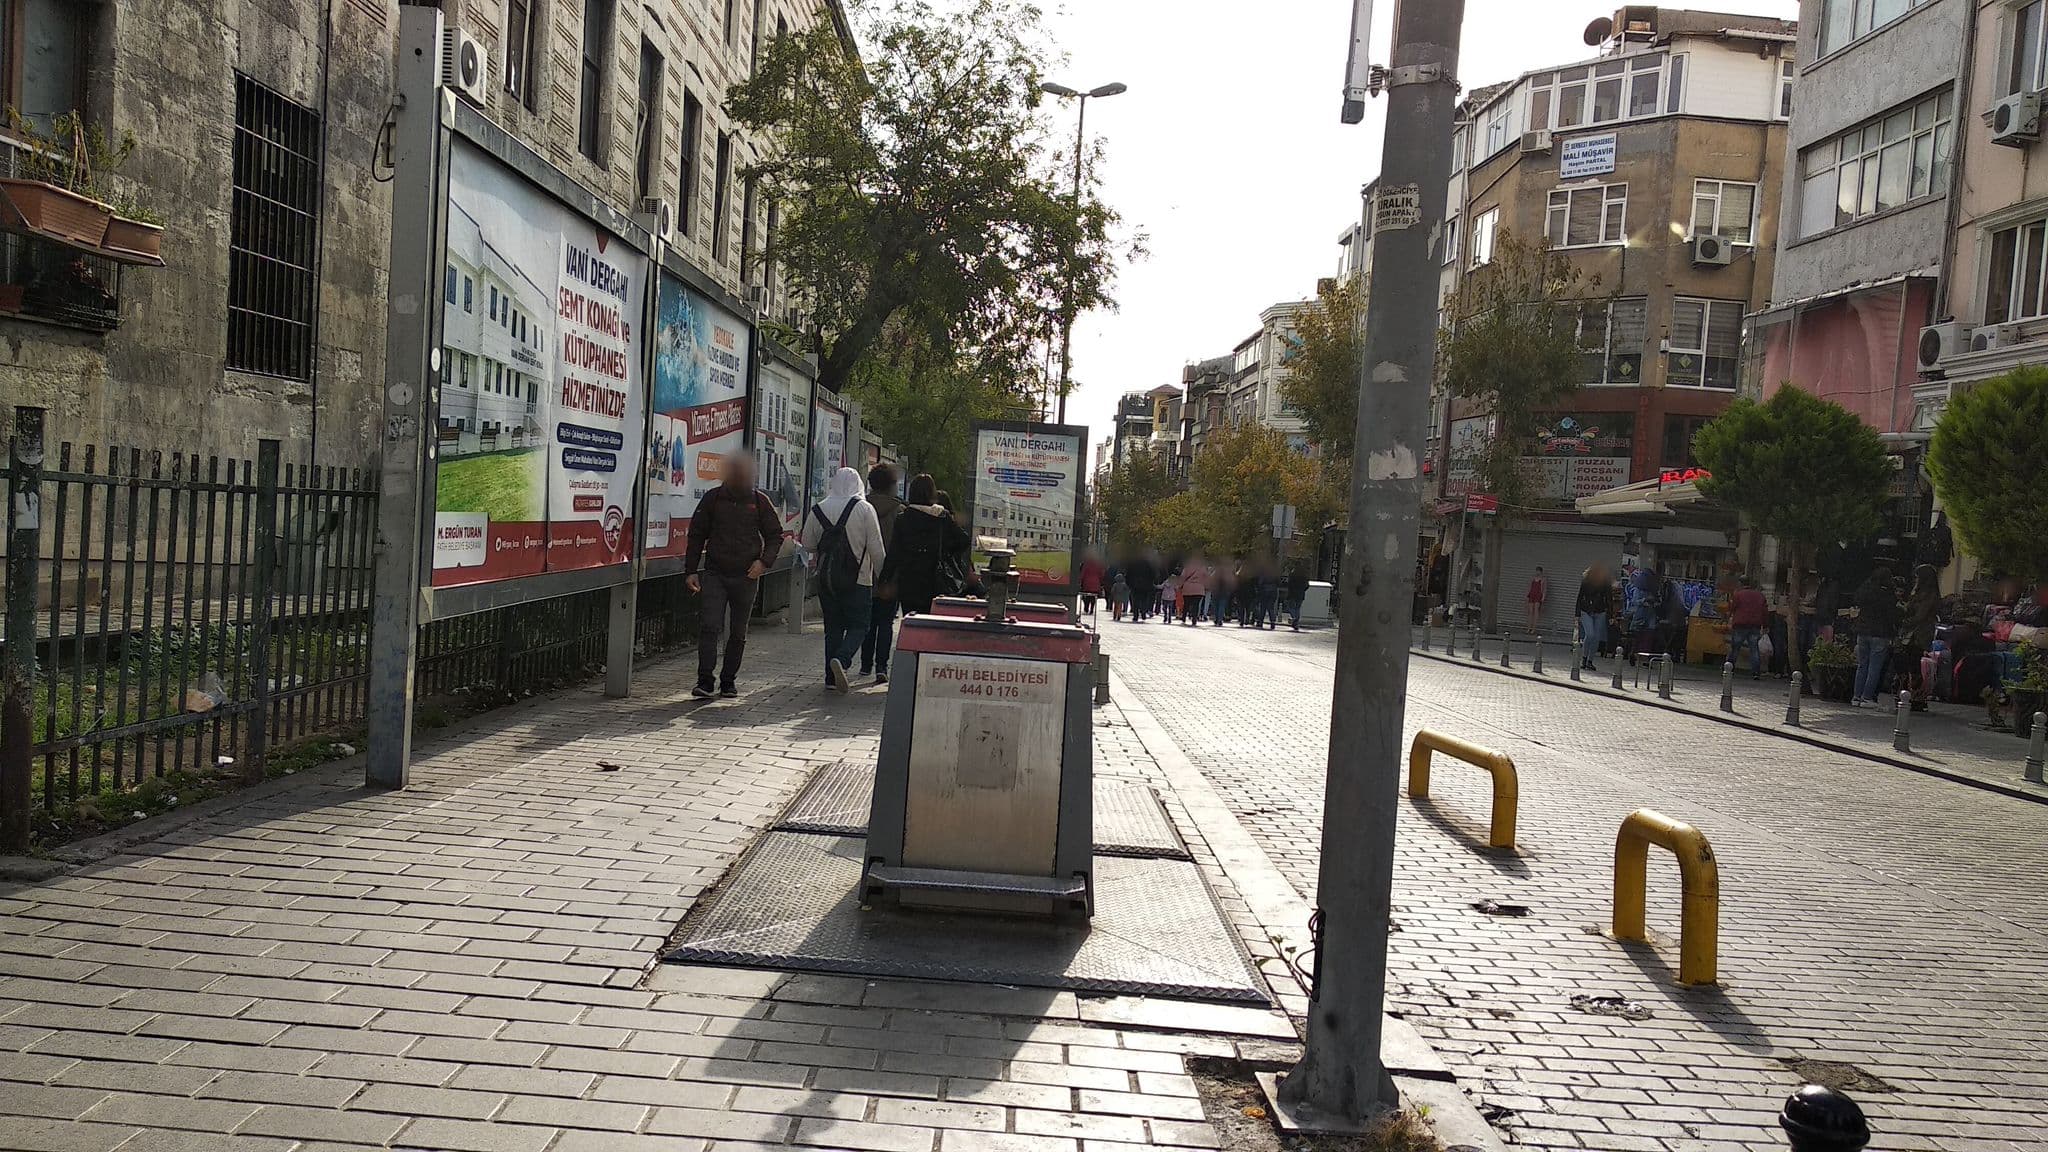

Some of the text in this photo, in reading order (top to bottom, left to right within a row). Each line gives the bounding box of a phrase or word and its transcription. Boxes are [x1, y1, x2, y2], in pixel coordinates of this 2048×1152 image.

[1563, 147, 1613, 160] MALİ MÜŞAVİR
[567, 243, 629, 303] VANİ DERGAHI
[559, 285, 584, 323] SEMT
[587, 298, 620, 339] KONAĞI
[564, 329, 627, 380] KÜTÜPHANESİ
[561, 372, 627, 418] HİZMETİNİZDE
[994, 436, 1066, 452] VANİ DERGAHI
[445, 525, 463, 539] ERGÜN
[464, 527, 482, 538] TURAN
[932, 666, 1049, 685] FATİH BELEDİYESİ
[960, 683, 1019, 697] 444 0 176
